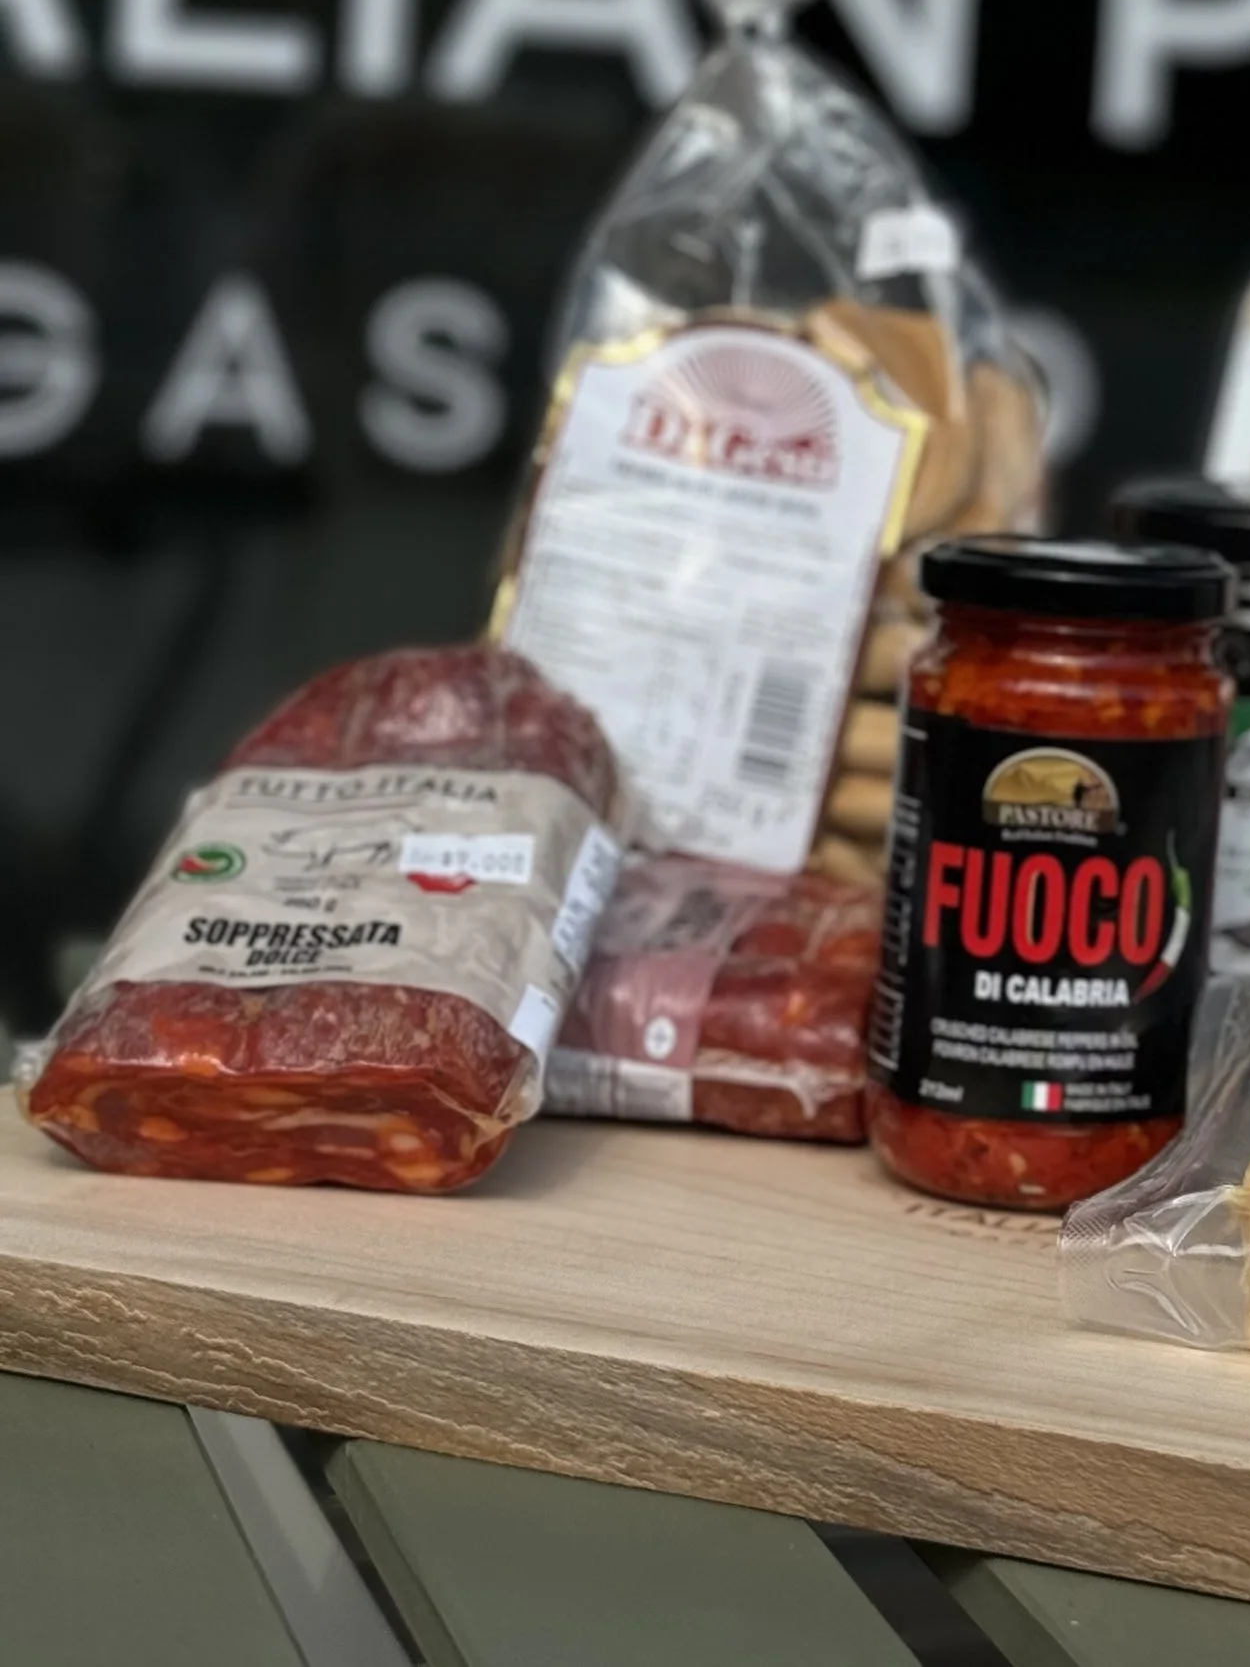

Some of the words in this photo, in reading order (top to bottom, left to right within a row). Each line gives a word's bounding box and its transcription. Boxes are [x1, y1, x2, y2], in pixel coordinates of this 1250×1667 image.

[237, 776, 366, 803] TUTTO
[373, 774, 499, 804] ITALIA
[998, 803, 1100, 832] PASTORE
[922, 839, 1166, 966] FUOCO
[183, 916, 403, 950] SOPPRESSATA
[245, 947, 324, 966] DOLCE
[973, 970, 1002, 1001] DI
[1005, 974, 1130, 1006] CALABRIA
